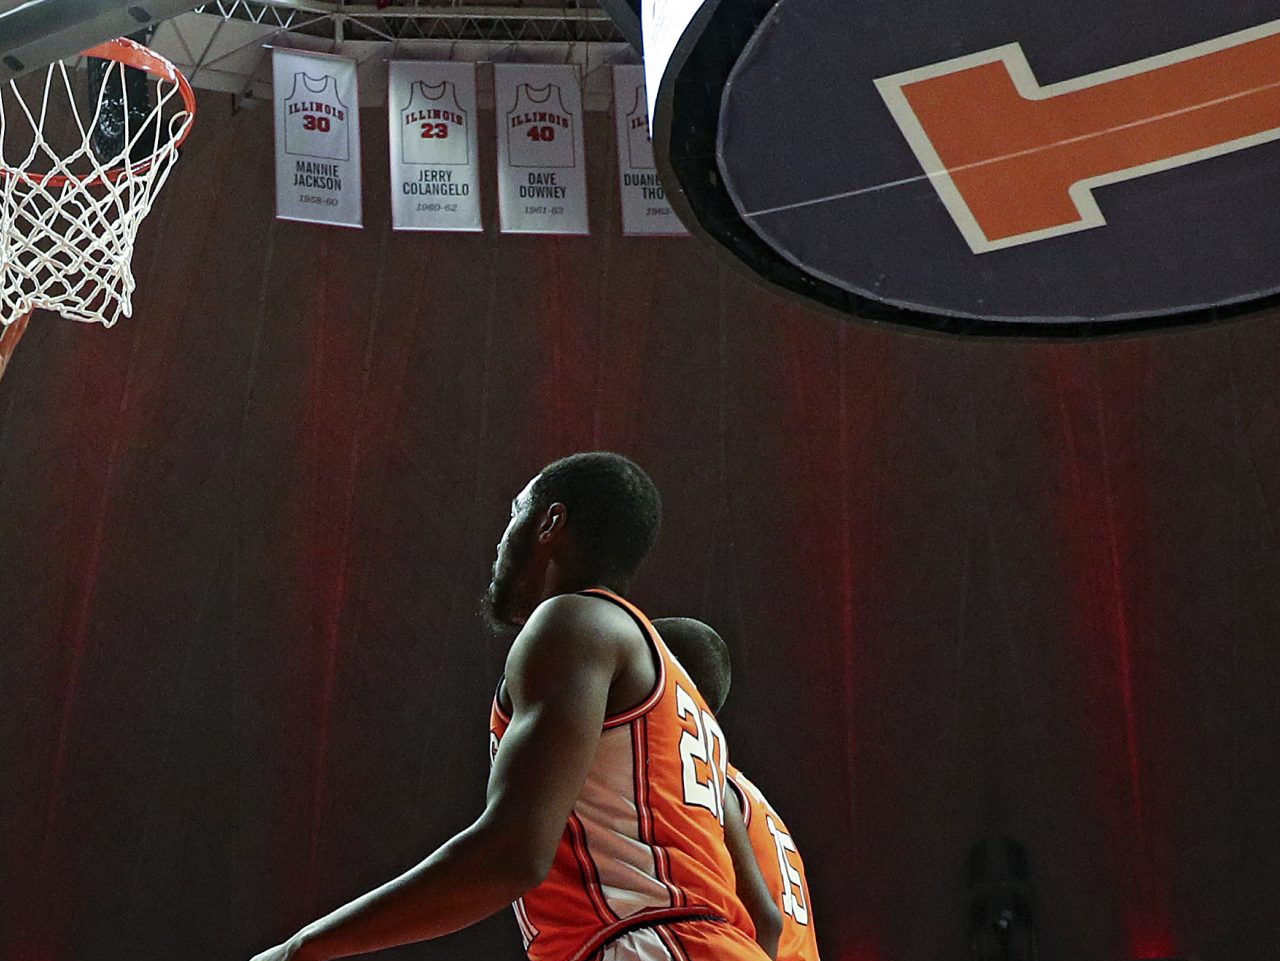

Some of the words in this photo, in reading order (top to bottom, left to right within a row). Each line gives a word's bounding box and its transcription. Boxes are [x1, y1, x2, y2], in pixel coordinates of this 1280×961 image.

[289, 101, 345, 122] ILLINOIS
[405, 108, 464, 126] ILLINOIS
[511, 111, 569, 128] ILLINOIS
[302, 114, 331, 133] 30
[421, 122, 449, 139] 23
[526, 125, 555, 142] 40
[296, 160, 340, 178] MANNIE
[419, 170, 453, 182] JERRY
[294, 173, 342, 191] JACKSON
[528, 173, 557, 186] DAVE
[403, 183, 470, 197] COLANGELO
[520, 186, 567, 200] DOWNEY
[766, 815, 809, 926] 15
